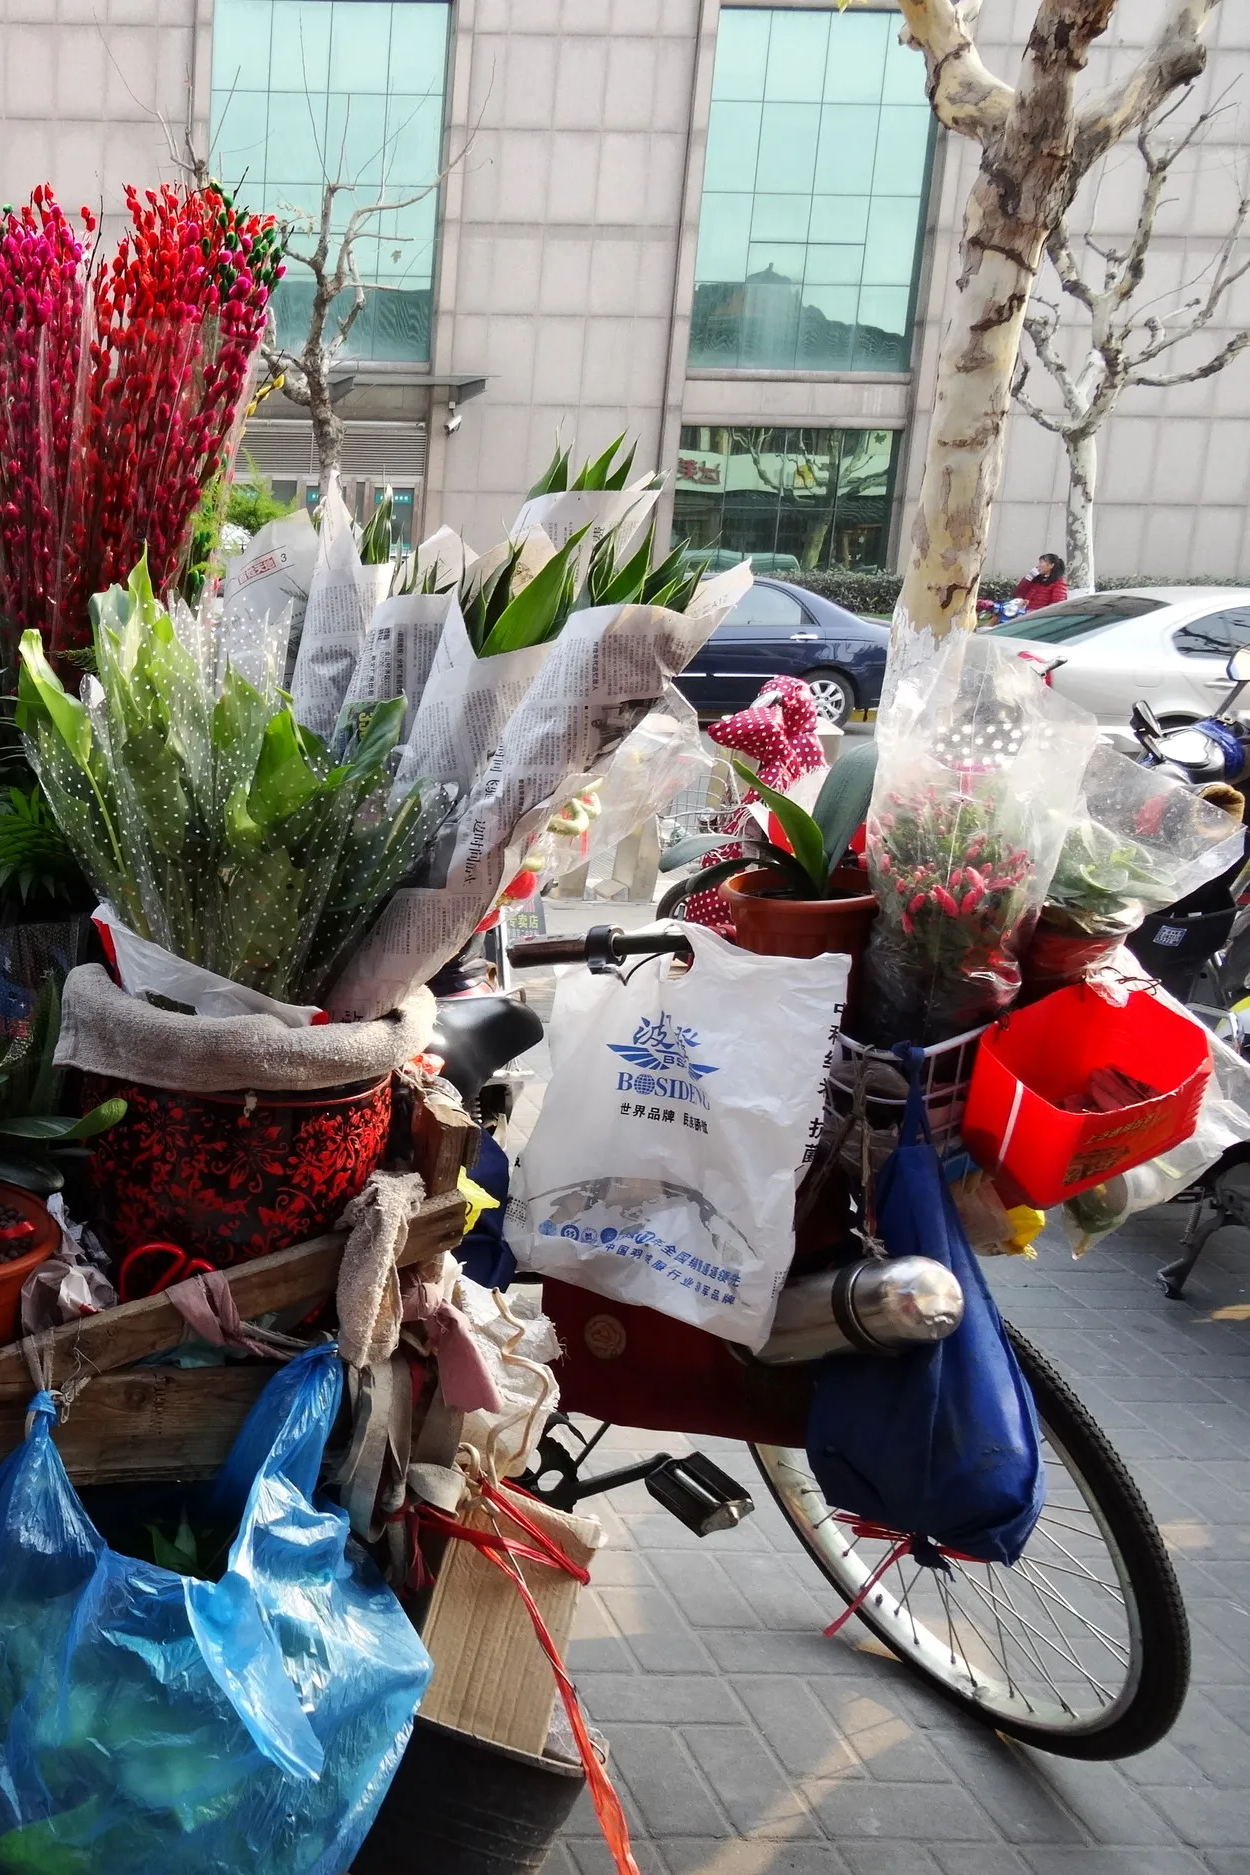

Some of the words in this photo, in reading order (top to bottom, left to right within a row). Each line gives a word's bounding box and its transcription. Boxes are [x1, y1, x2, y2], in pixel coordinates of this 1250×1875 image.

[280, 553, 287, 563] 3
[620, 1102, 675, 1124] 世界品牌
